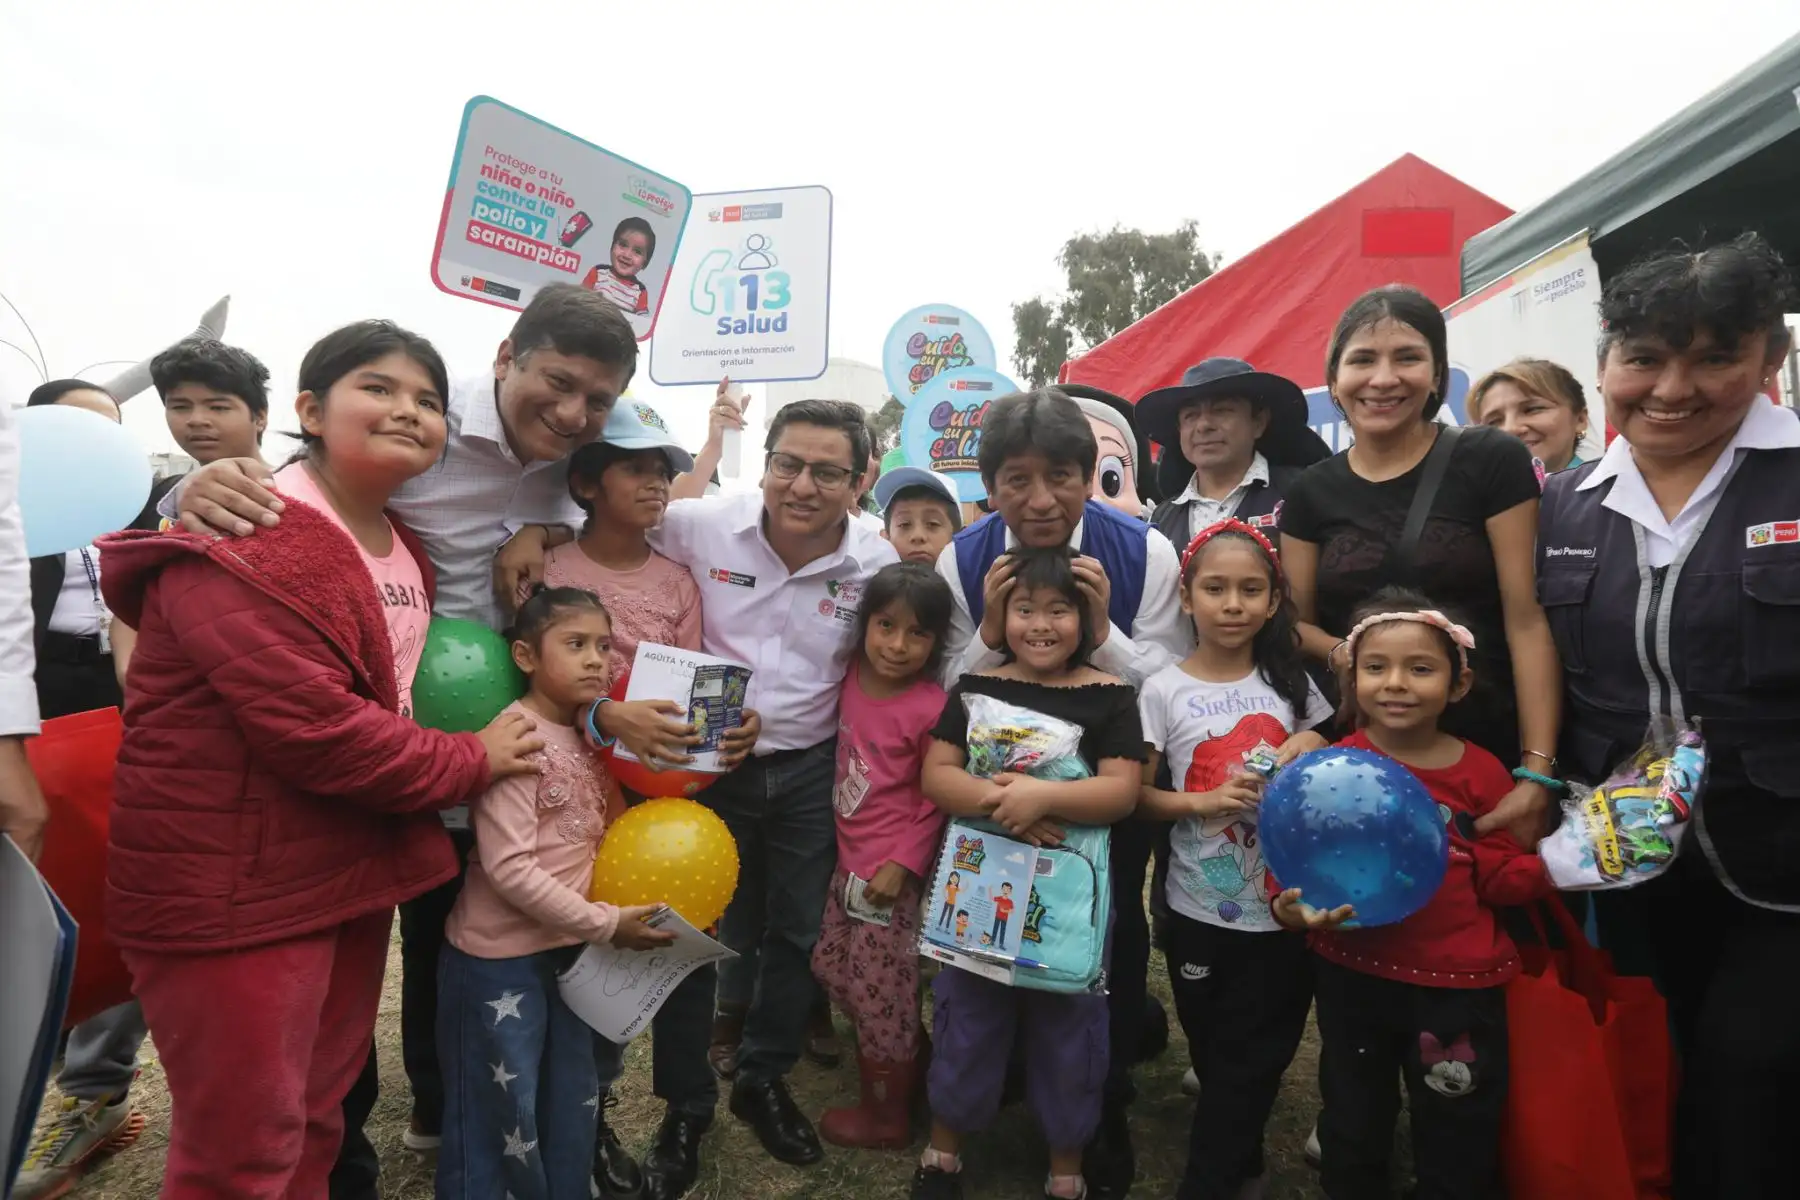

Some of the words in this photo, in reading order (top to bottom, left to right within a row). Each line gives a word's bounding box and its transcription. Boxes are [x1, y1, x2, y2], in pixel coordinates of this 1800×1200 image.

[484, 145, 536, 175] Protege
[538, 168, 549, 180] a
[550, 171, 563, 186] tu
[480, 163, 522, 190] niña
[524, 179, 536, 193] o
[538, 184, 575, 209] niño
[476, 180, 537, 210] contra
[541, 199, 556, 218] la
[475, 201, 526, 230] polio
[529, 219, 543, 239] y
[469, 224, 578, 271] sarampión
[717, 271, 792, 313] 113
[1533, 269, 1584, 297] Siempre
[716, 312, 788, 336] Salud
[682, 349, 732, 358] Orientación
[907, 333, 967, 358] Cuida
[720, 357, 754, 368] gratuita
[920, 355, 936, 365] su
[930, 401, 993, 431] Cuid
[944, 427, 960, 439] su
[644, 651, 676, 665] AGÜITA
[679, 659, 687, 667] Y
[1225, 689, 1240, 699] LA
[1187, 695, 1278, 719] SIRENITA
[676, 962, 689, 974] EL
[1184, 962, 1210, 976] NIKE
[656, 970, 679, 997] CICLO
[643, 996, 658, 1014] DEL
[620, 1015, 643, 1037] AGUA
